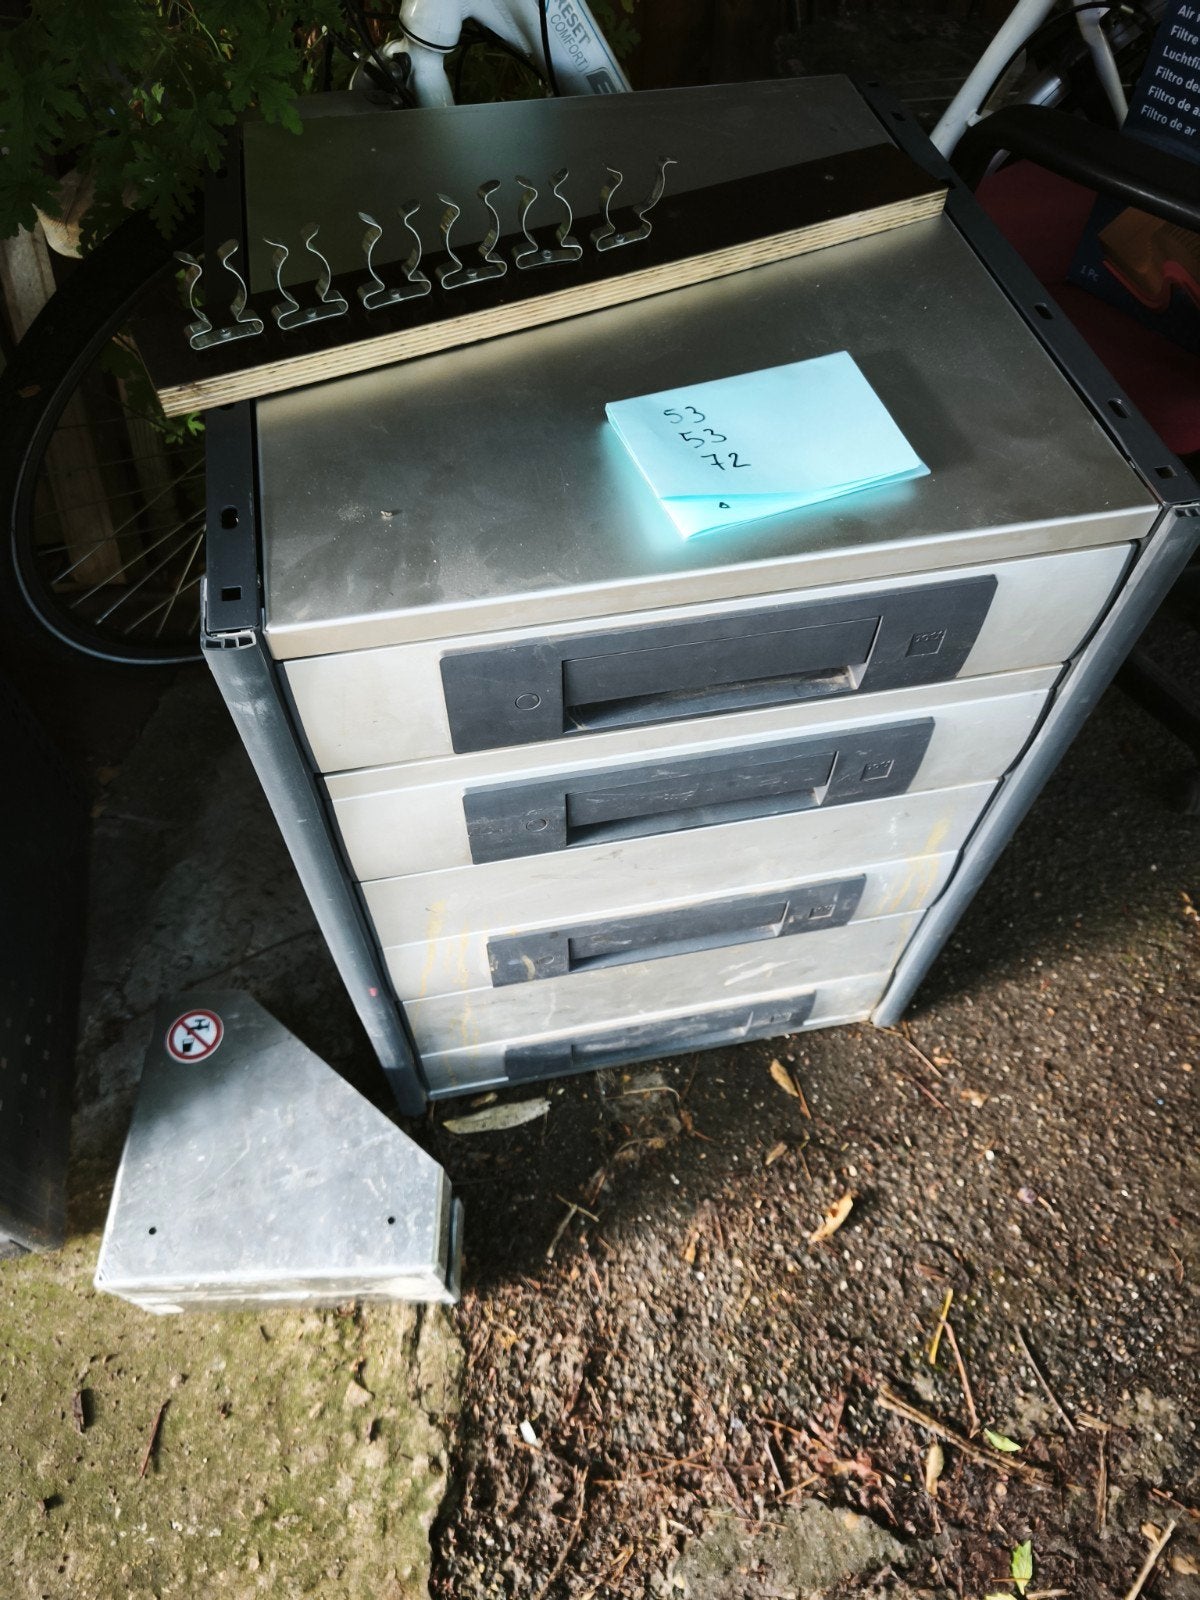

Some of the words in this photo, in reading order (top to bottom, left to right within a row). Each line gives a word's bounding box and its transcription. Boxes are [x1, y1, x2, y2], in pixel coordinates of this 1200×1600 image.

[1177, 4, 1196, 20] Air
[550, 14, 588, 67] COMFORT
[1170, 25, 1199, 46] Filtre
[1155, 65, 1184, 86] Filtro
[1148, 85, 1175, 105] Filtro
[1177, 98, 1191, 113] de
[1192, 104, 1200, 117] a
[1140, 104, 1168, 125] Filtro
[1169, 117, 1183, 131] de
[1184, 125, 1197, 137] ar
[663, 405, 706, 424] 53
[678, 427, 727, 449] 53
[700, 451, 752, 471] 72
